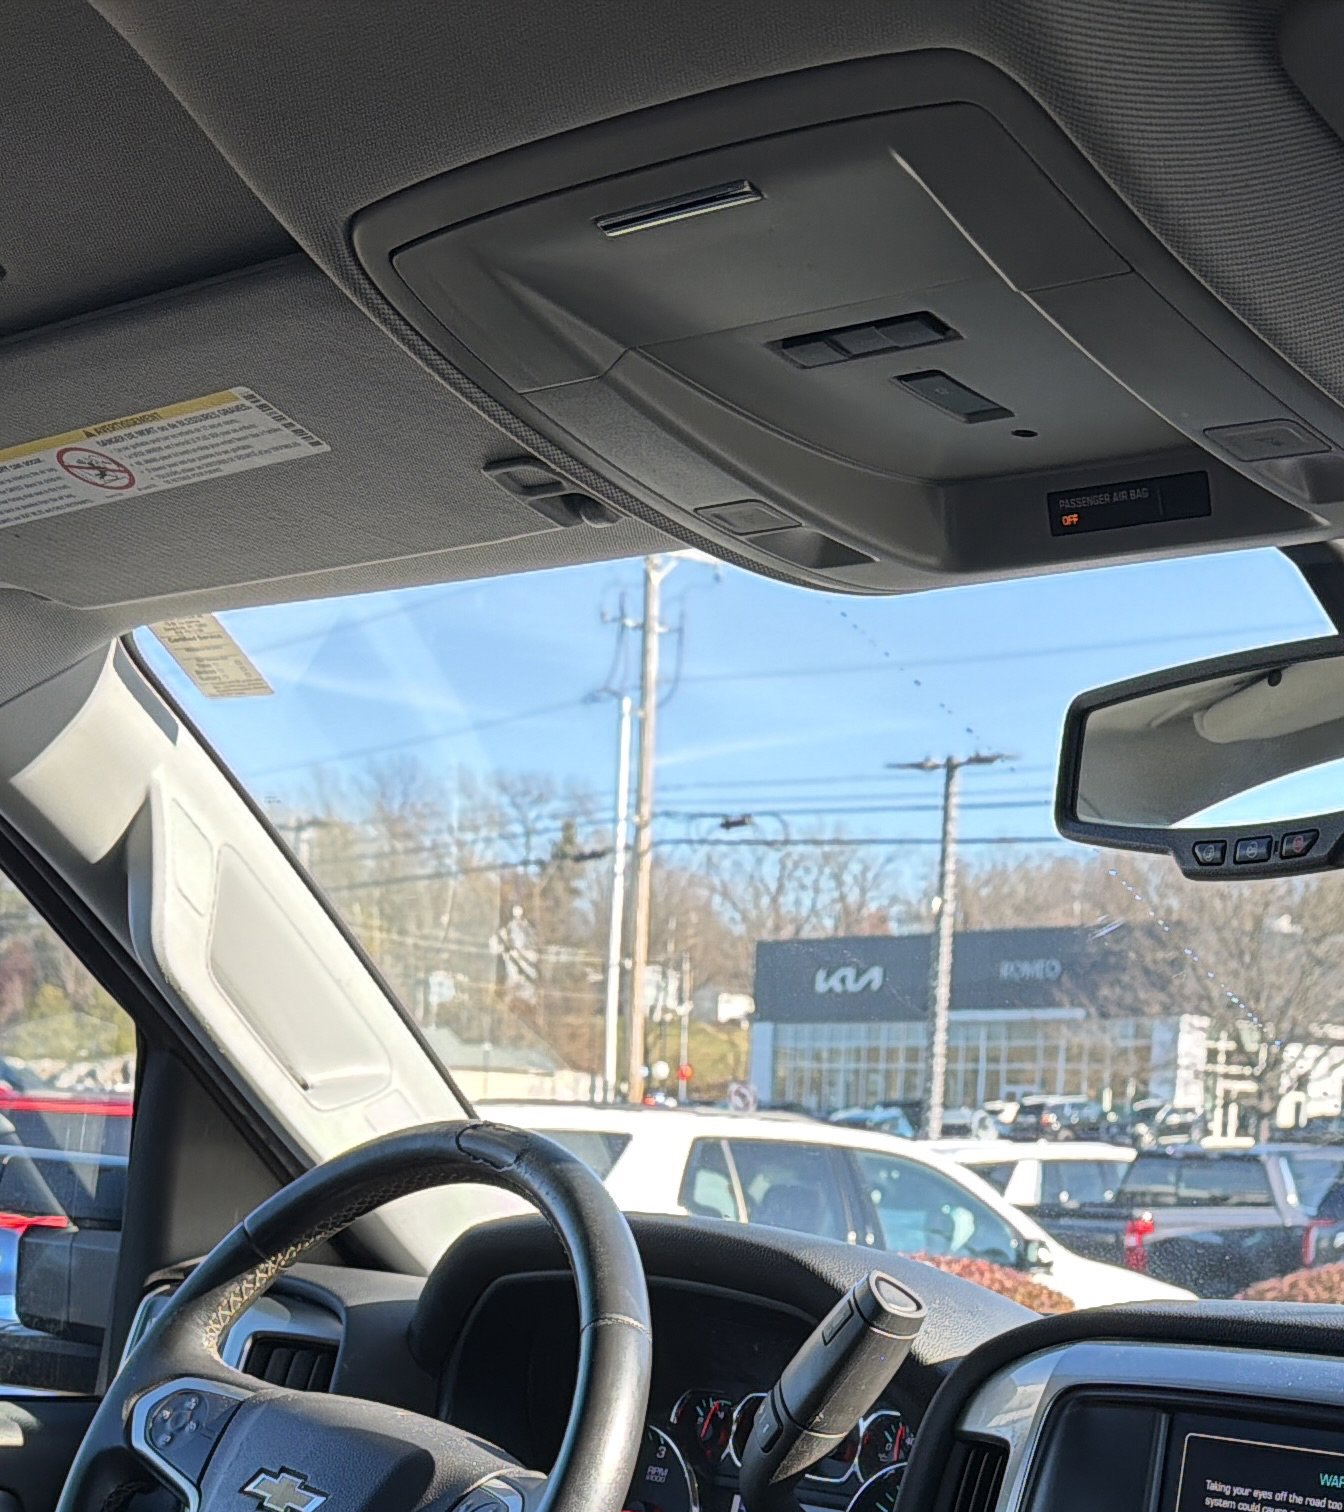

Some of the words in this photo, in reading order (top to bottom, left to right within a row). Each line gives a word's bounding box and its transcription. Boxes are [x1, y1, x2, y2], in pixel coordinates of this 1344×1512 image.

[1059, 494, 1111, 510] PASSENGER
[1112, 491, 1128, 504] AIR
[1129, 487, 1149, 501] BAG
[1061, 513, 1080, 527] OFF
[656, 1446, 667, 1459] 3
[1206, 1479, 1231, 1496] Taking
[1232, 1485, 1252, 1497] your
[1253, 1488, 1273, 1500] eyes
[1275, 1490, 1288, 1502] off
[1289, 1492, 1303, 1505] the
[1306, 1496, 1326, 1509] road
[1328, 1498, 1343, 1511] too
[1205, 1496, 1236, 1509] system
